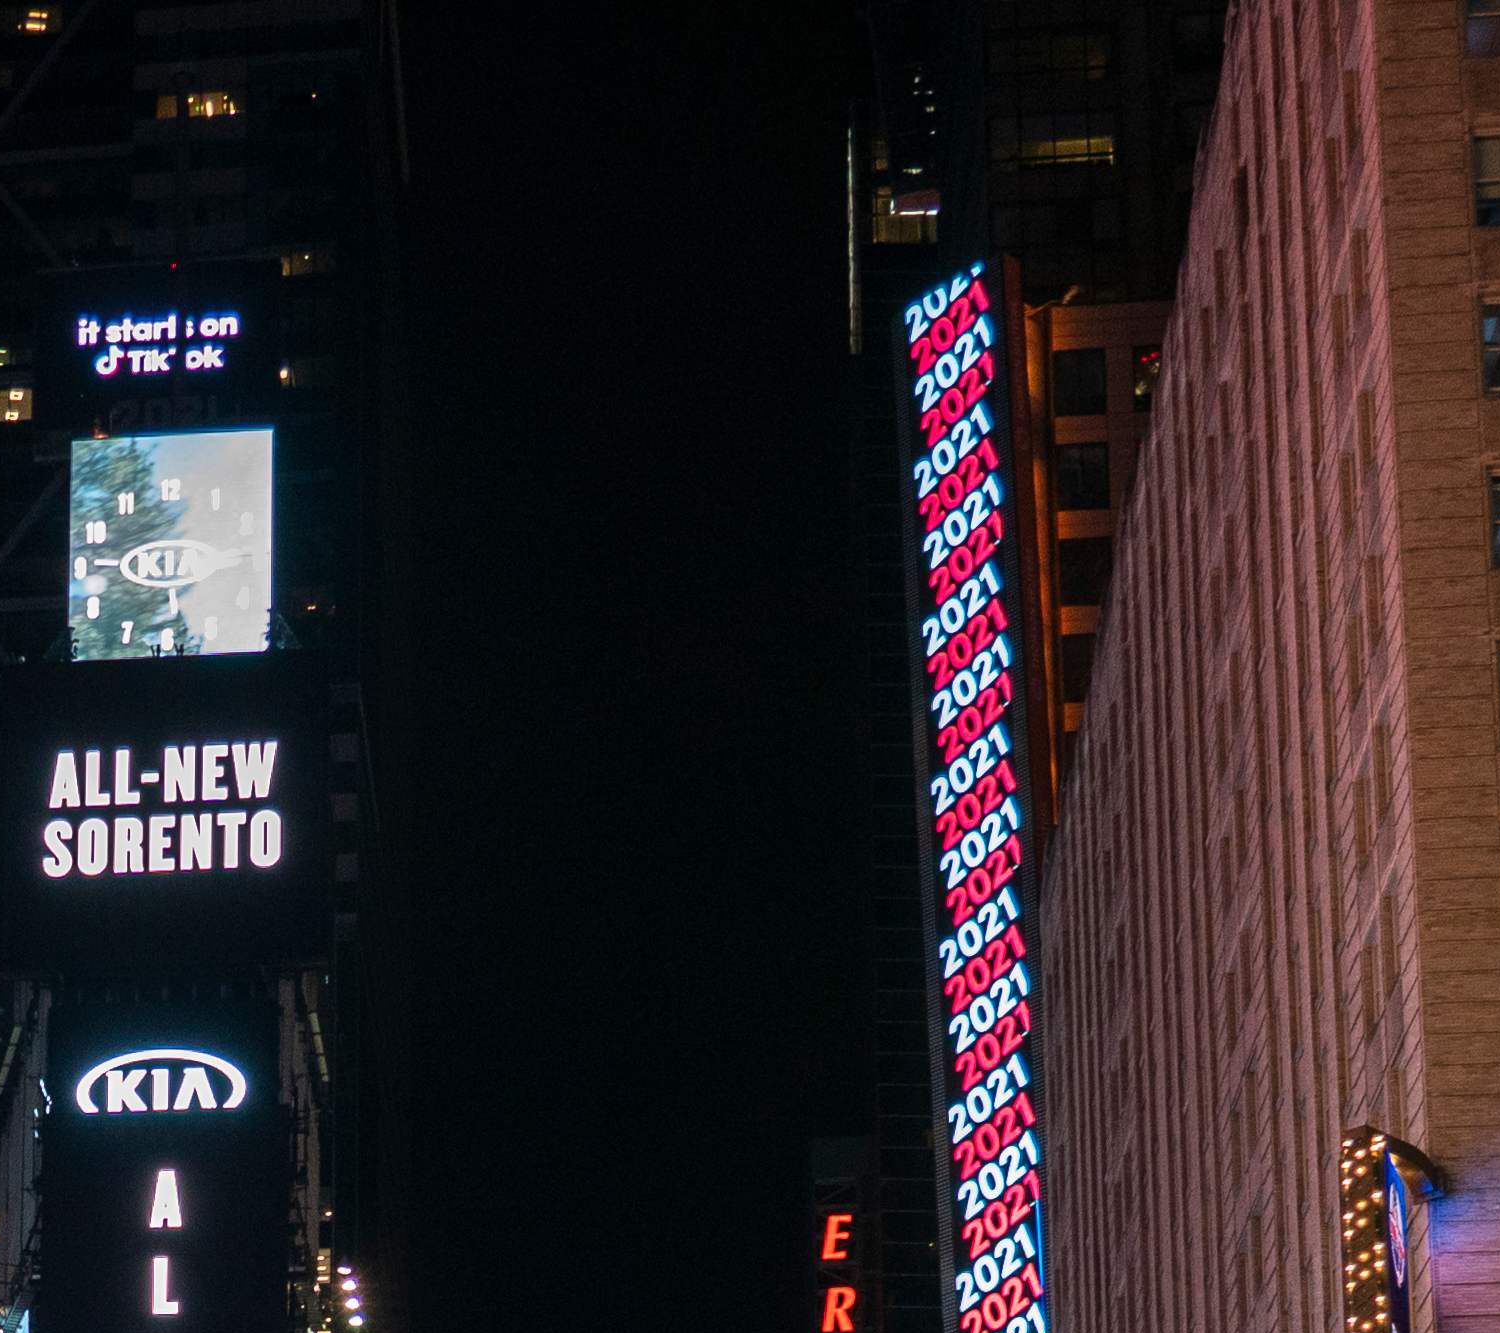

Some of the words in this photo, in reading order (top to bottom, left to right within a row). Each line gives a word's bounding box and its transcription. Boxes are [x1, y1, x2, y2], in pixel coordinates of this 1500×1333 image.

[78, 319, 100, 346] it
[200, 315, 239, 337] on
[127, 345, 224, 373] Tikok
[911, 281, 989, 376] 2021
[920, 352, 993, 448] 2021
[919, 437, 998, 532] 2021
[929, 511, 1003, 605] 2021
[927, 599, 1008, 691] 2021
[937, 672, 1013, 764] 2021
[48, 741, 279, 810] ALL-NEW
[936, 760, 1016, 851] 2021
[42, 809, 283, 879] SORENTO
[946, 834, 1021, 925] 2021
[944, 924, 1027, 1015] 2021
[105, 1066, 213, 1112] KIA
[955, 1001, 1030, 1091] 2021
[953, 1091, 1037, 1181] 2021
[963, 1169, 1041, 1258] 2021
